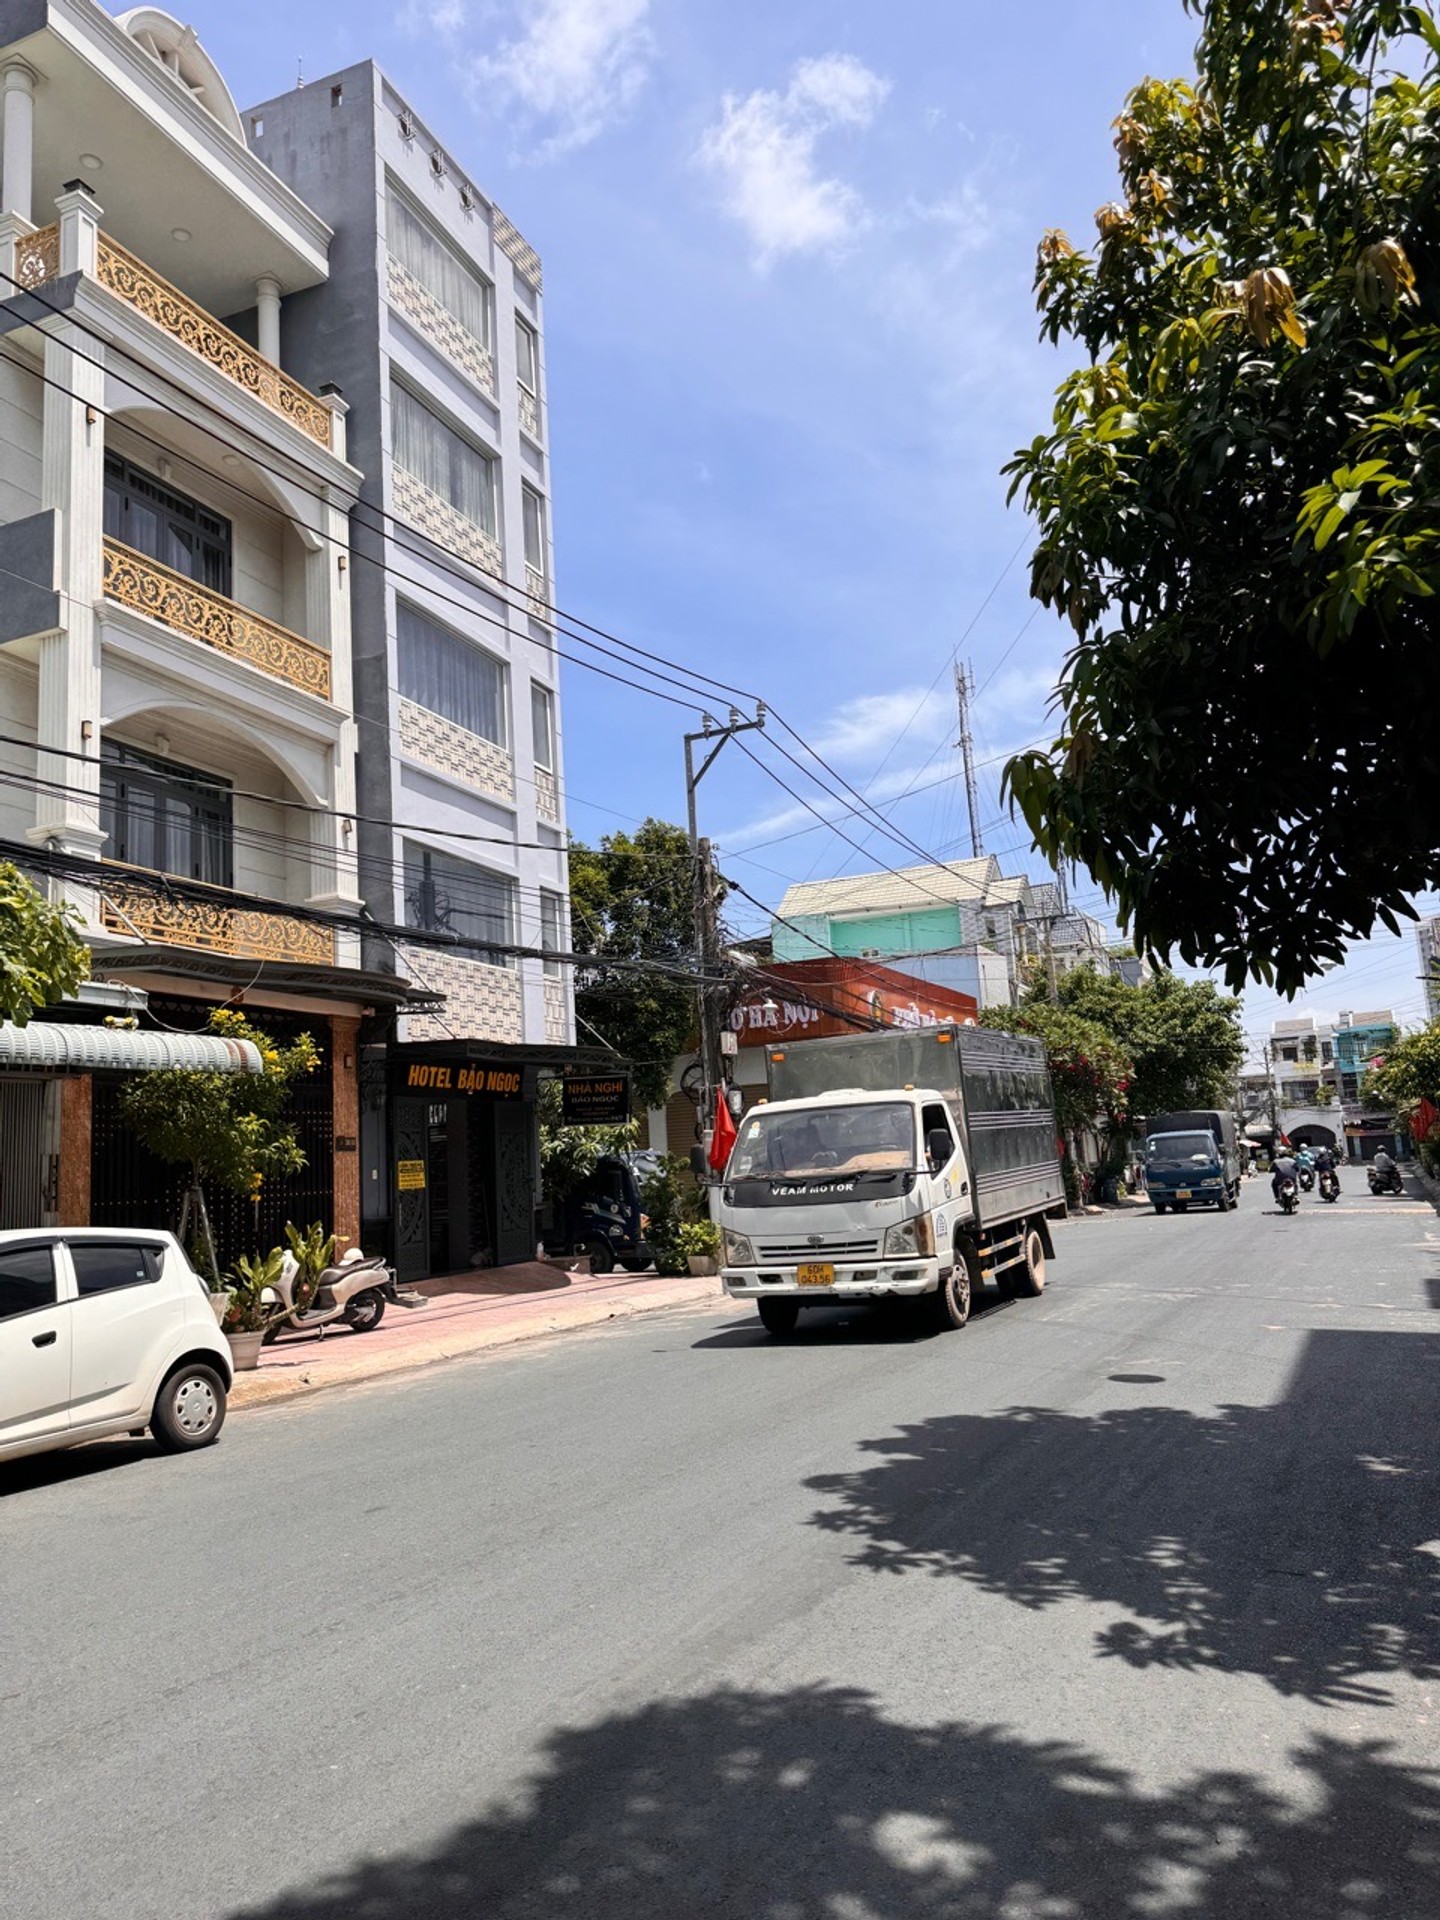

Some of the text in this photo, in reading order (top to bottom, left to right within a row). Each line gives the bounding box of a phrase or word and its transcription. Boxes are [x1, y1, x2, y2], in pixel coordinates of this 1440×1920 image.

[408, 1064, 452, 1089] HOTEL
[486, 1070, 521, 1098] NGỌC
[772, 1183, 854, 1196] VEAM MOTOR
